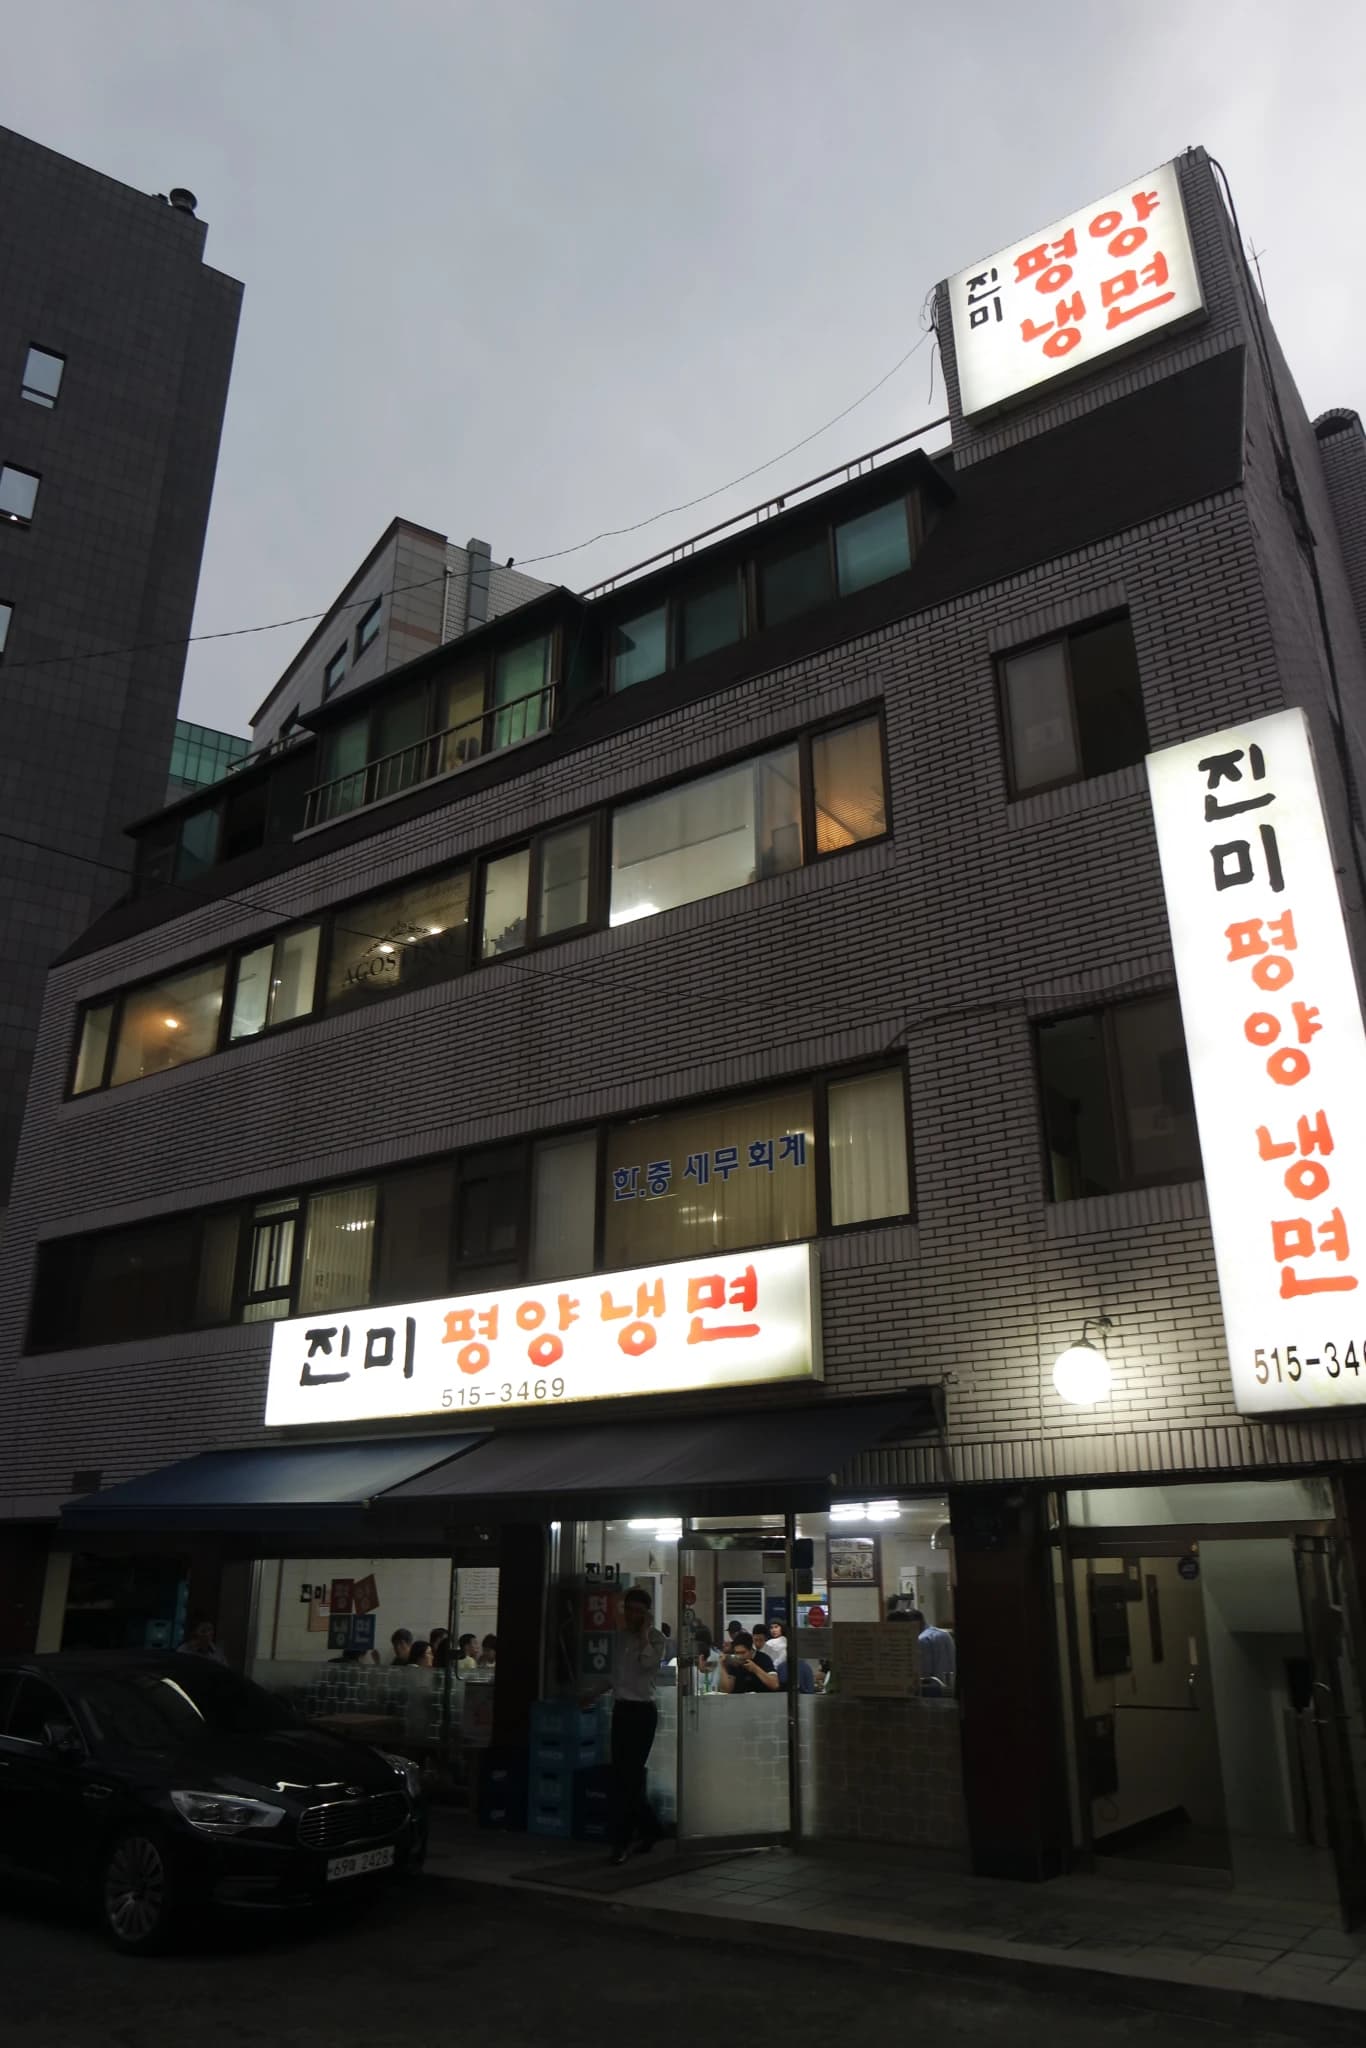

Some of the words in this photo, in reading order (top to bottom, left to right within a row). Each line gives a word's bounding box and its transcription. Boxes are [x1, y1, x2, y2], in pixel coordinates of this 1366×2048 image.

[1013, 191, 1160, 294] 평양
[966, 268, 1003, 330] 진미
[1020, 251, 1176, 358] 냉면
[1198, 744, 1285, 893] 진미
[300, 1316, 416, 1386] 진미
[1254, 1340, 1366, 1385] 515-34
[441, 1377, 565, 1408] 515-3469
[584, 1563, 620, 1585] 진미
